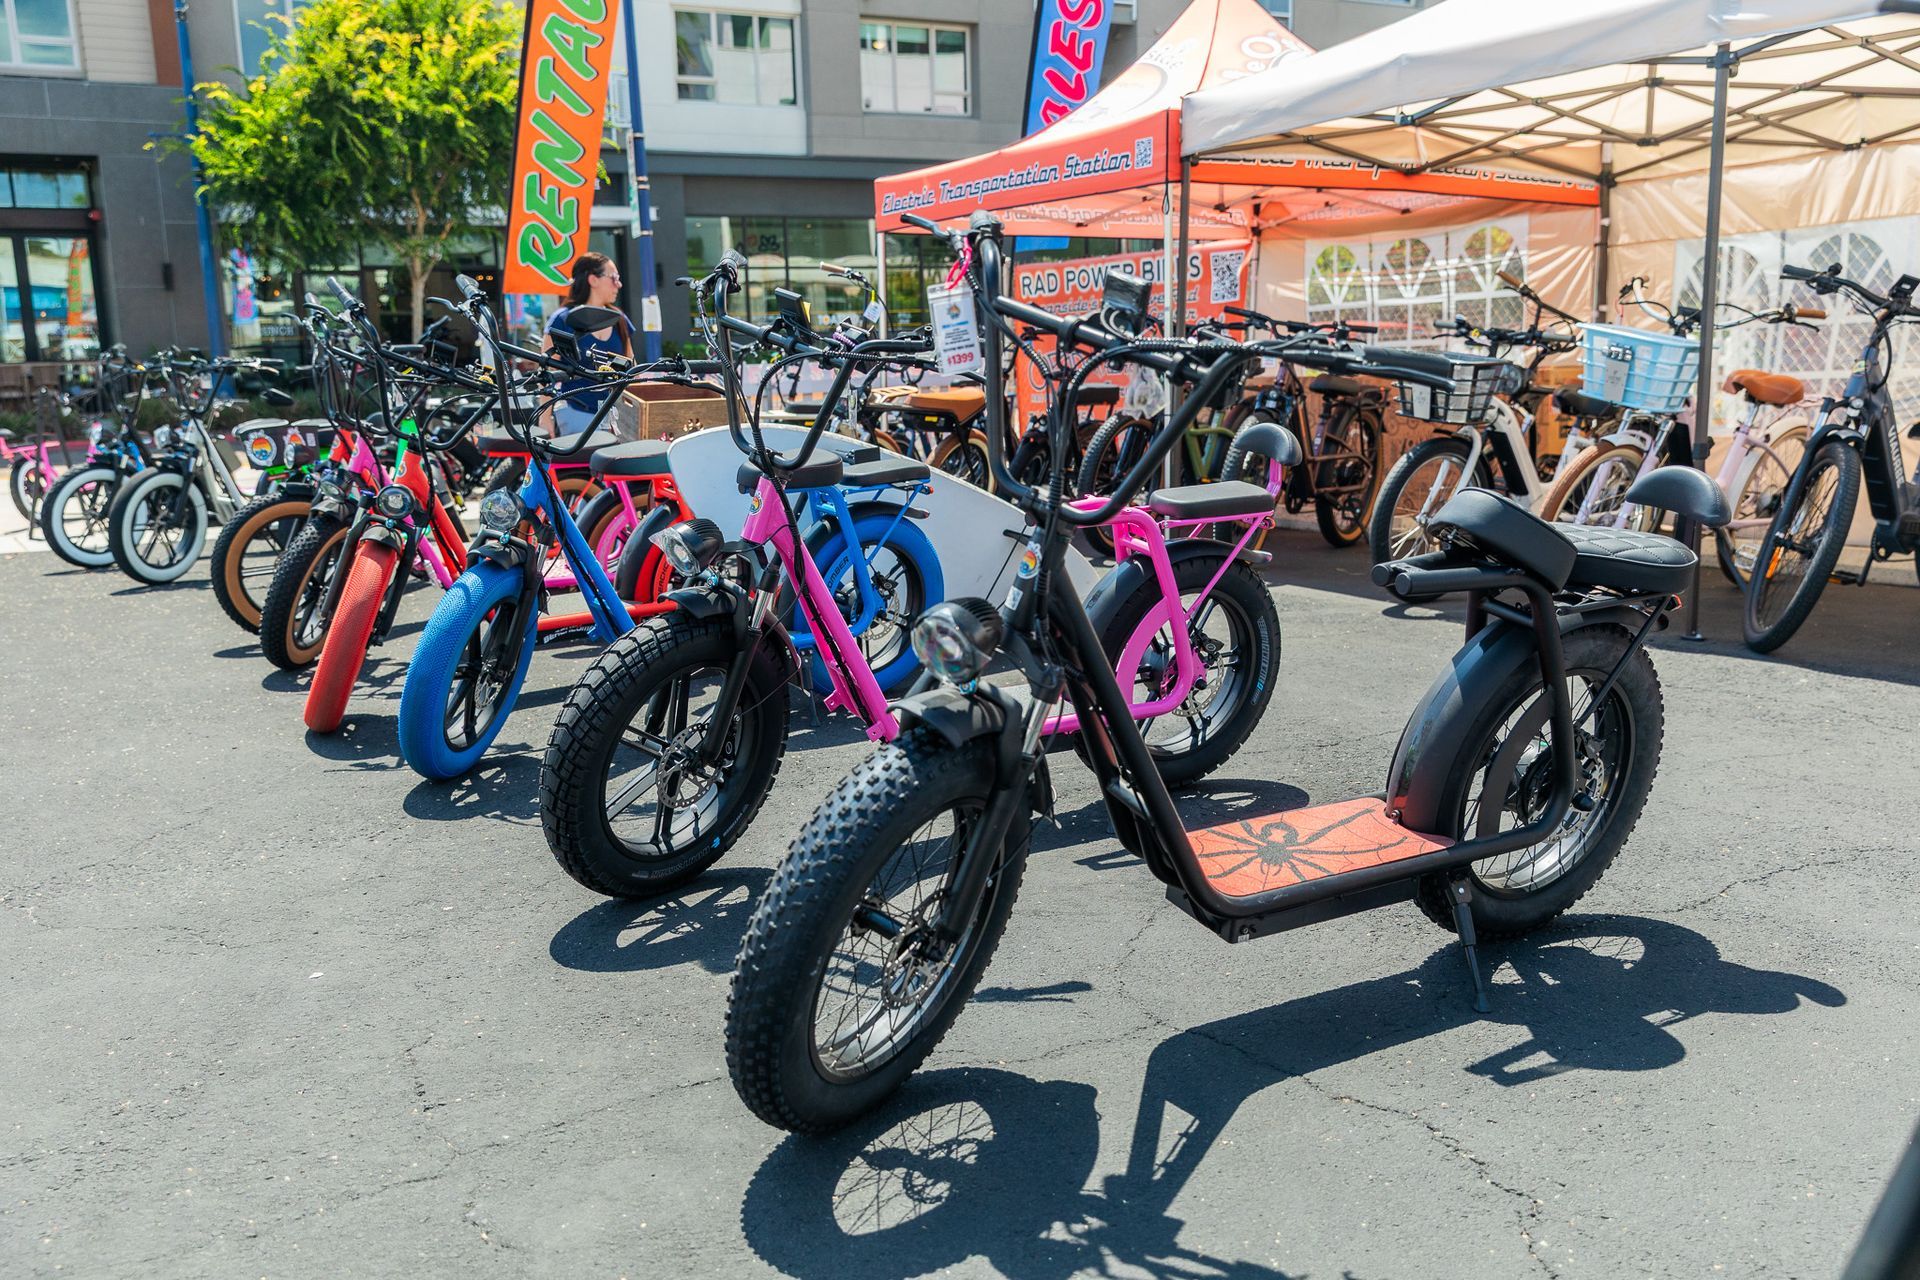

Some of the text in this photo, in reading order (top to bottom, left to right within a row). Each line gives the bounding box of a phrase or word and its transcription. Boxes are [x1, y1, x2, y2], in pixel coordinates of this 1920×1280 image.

[882, 150, 1132, 214] Electric Transportation Station
[1021, 255, 1201, 296] RAD POWR BIS
